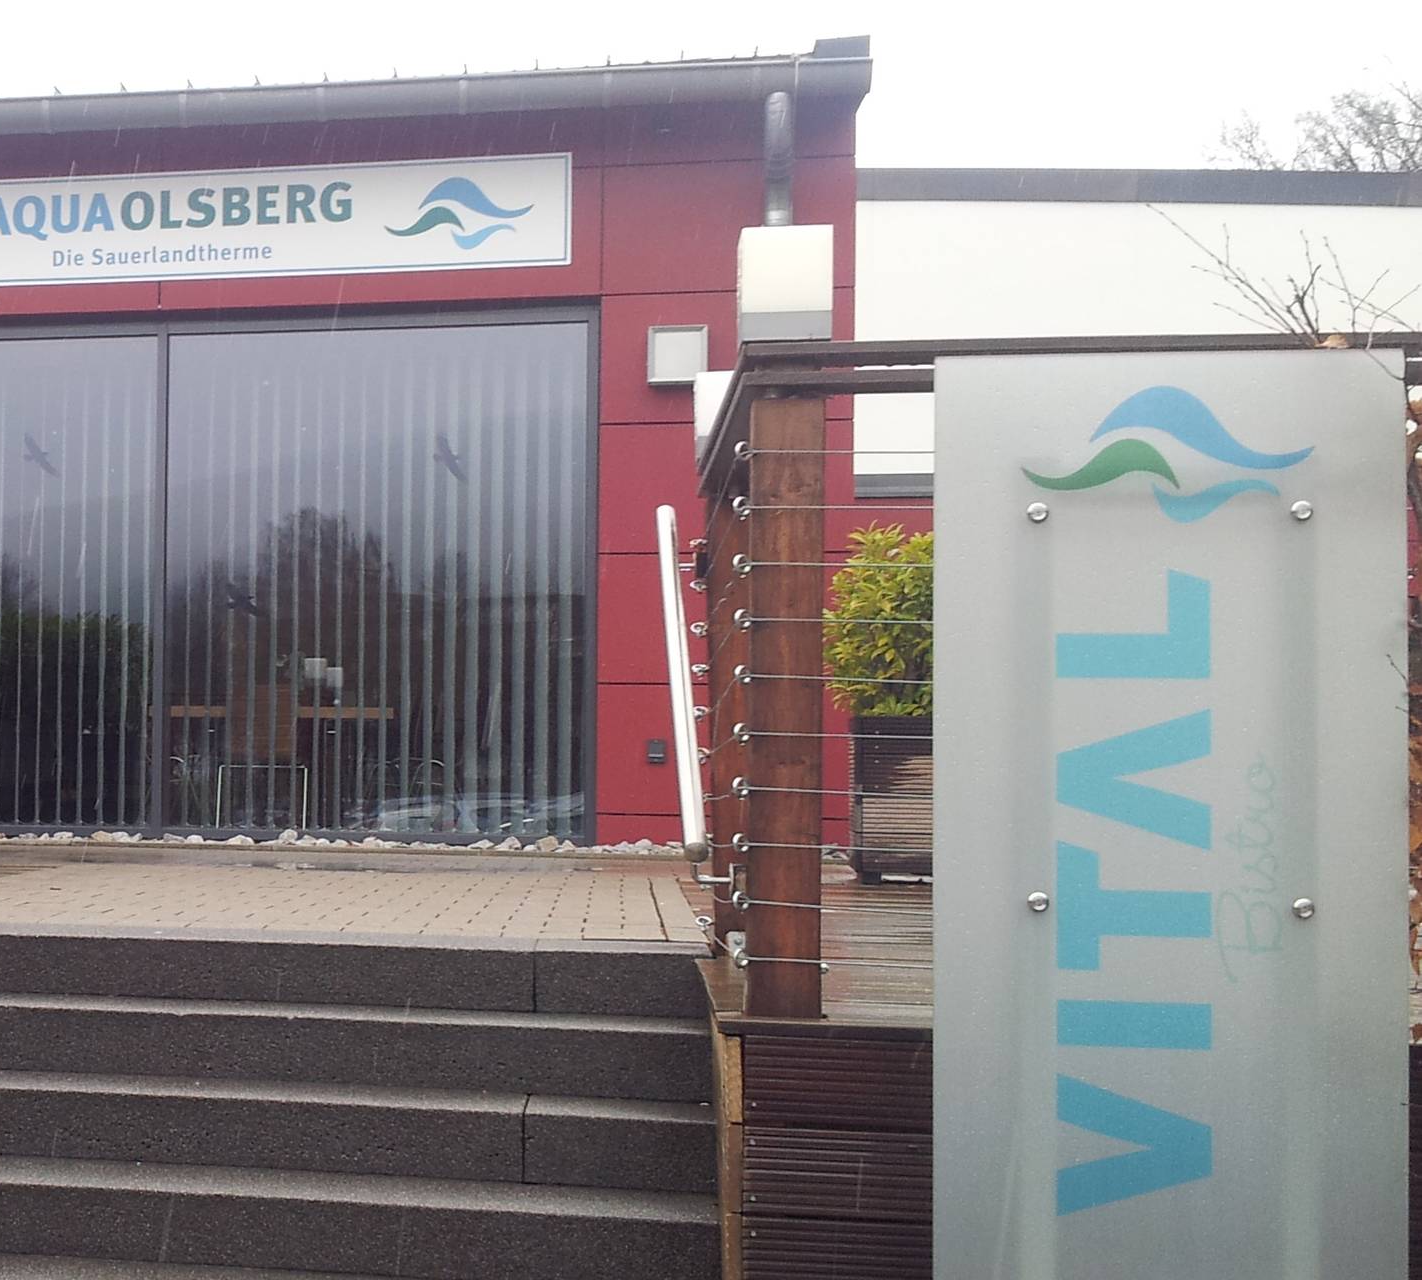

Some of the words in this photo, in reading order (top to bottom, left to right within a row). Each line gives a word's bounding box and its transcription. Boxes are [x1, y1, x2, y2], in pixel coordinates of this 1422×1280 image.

[52, 249, 84, 267] Die
[91, 243, 273, 266] Sauerlandtherme
[1055, 568, 1213, 1217] VITAL
[1216, 750, 1284, 983] Bistro
